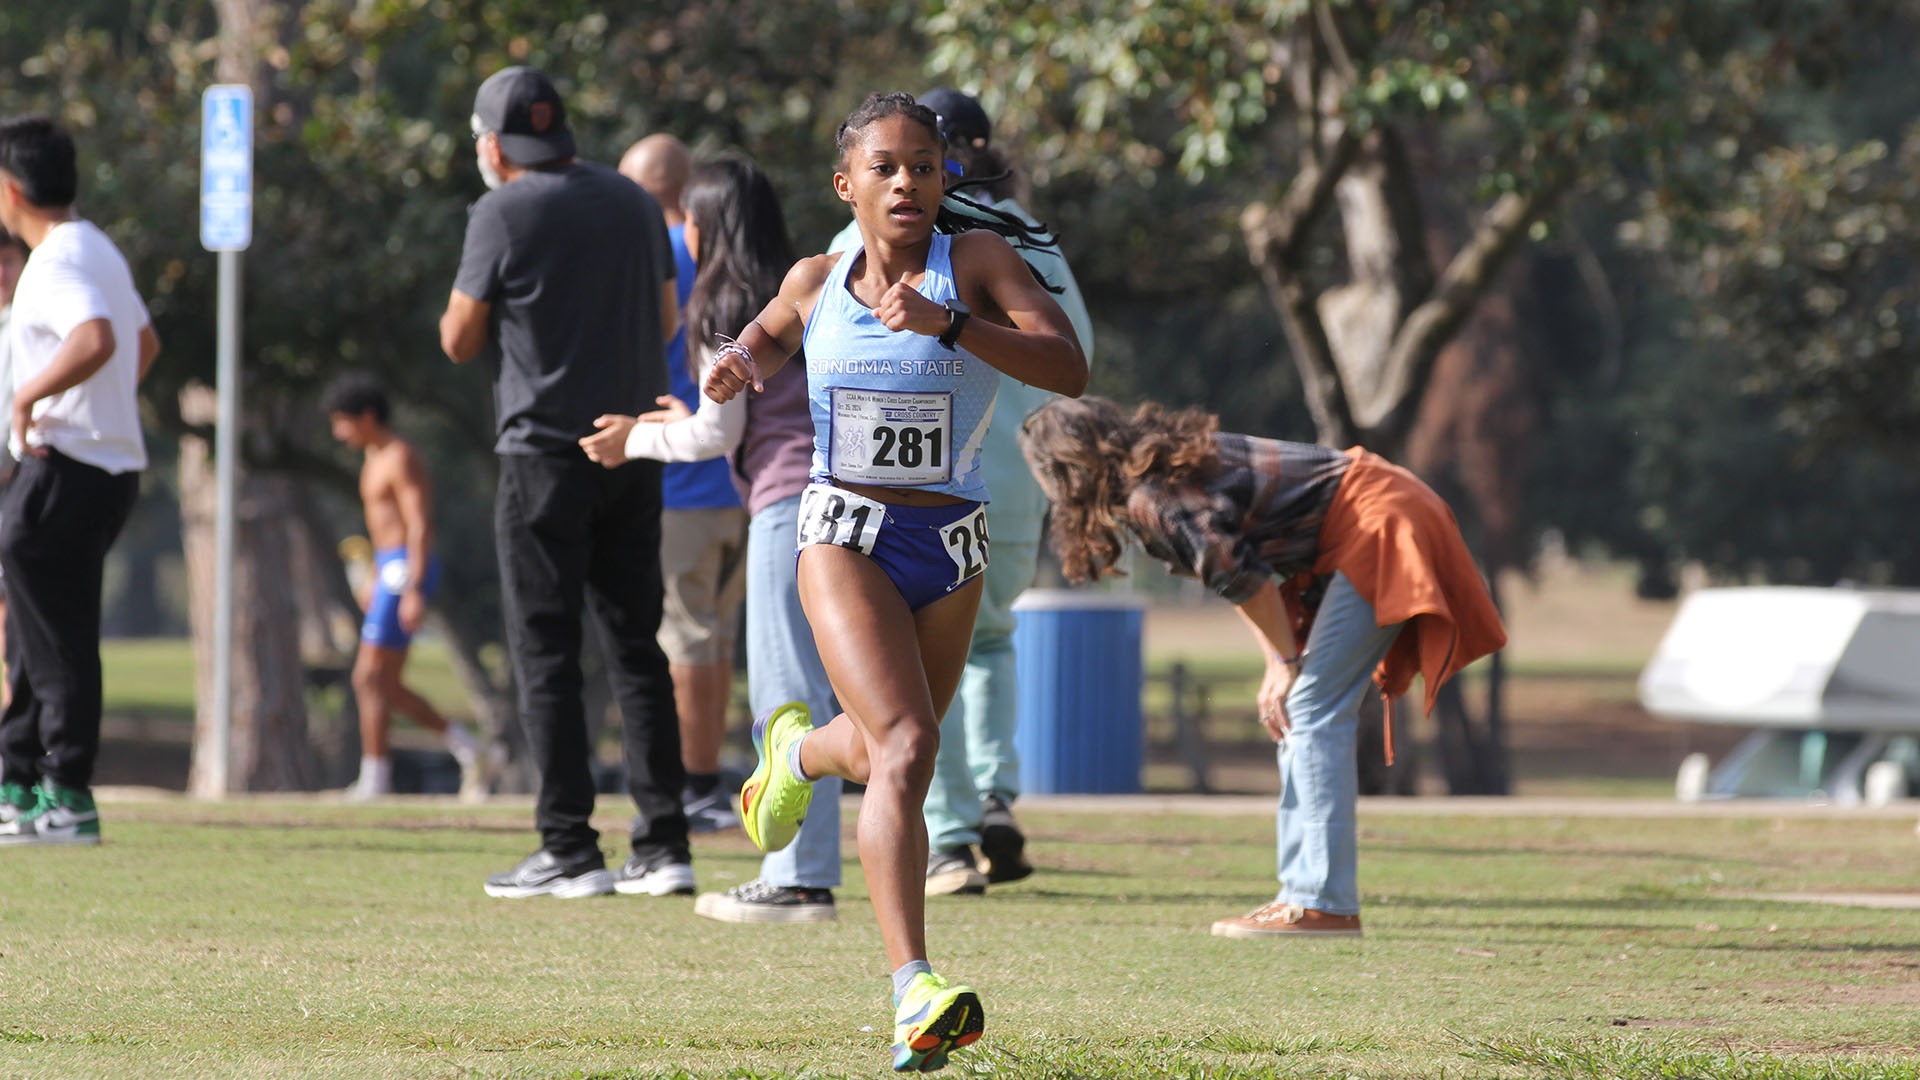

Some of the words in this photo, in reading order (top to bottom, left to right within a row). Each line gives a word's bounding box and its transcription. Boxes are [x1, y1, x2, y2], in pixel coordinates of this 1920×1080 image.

[809, 359, 894, 376] SONOMA
[899, 359, 965, 376] STATE
[872, 426, 942, 468] 281
